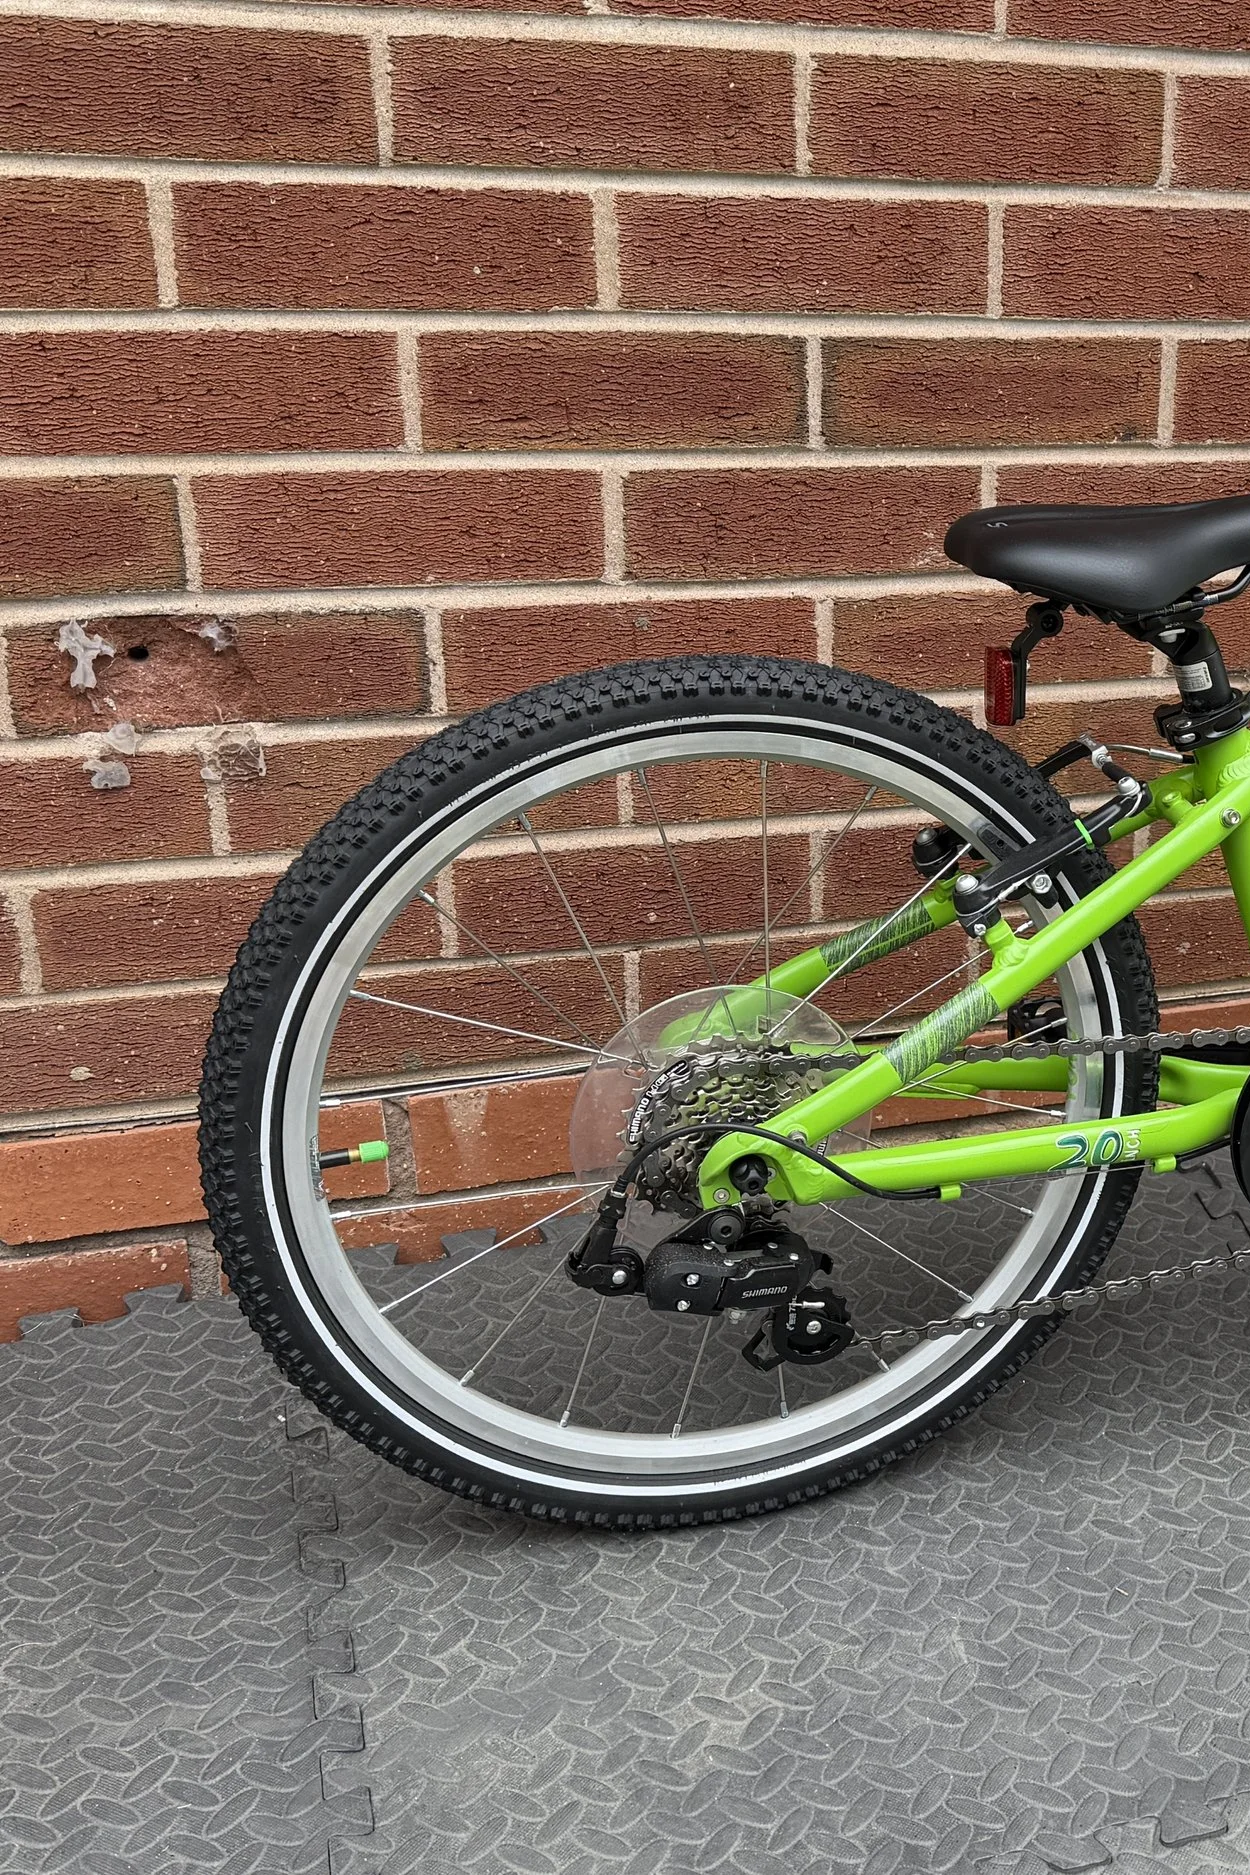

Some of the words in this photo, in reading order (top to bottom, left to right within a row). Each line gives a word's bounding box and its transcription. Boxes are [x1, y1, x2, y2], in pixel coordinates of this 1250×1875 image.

[1048, 1128, 1124, 1172] 20
[1124, 1128, 1142, 1161] INCH
[741, 1286, 788, 1299] SHIMANO
